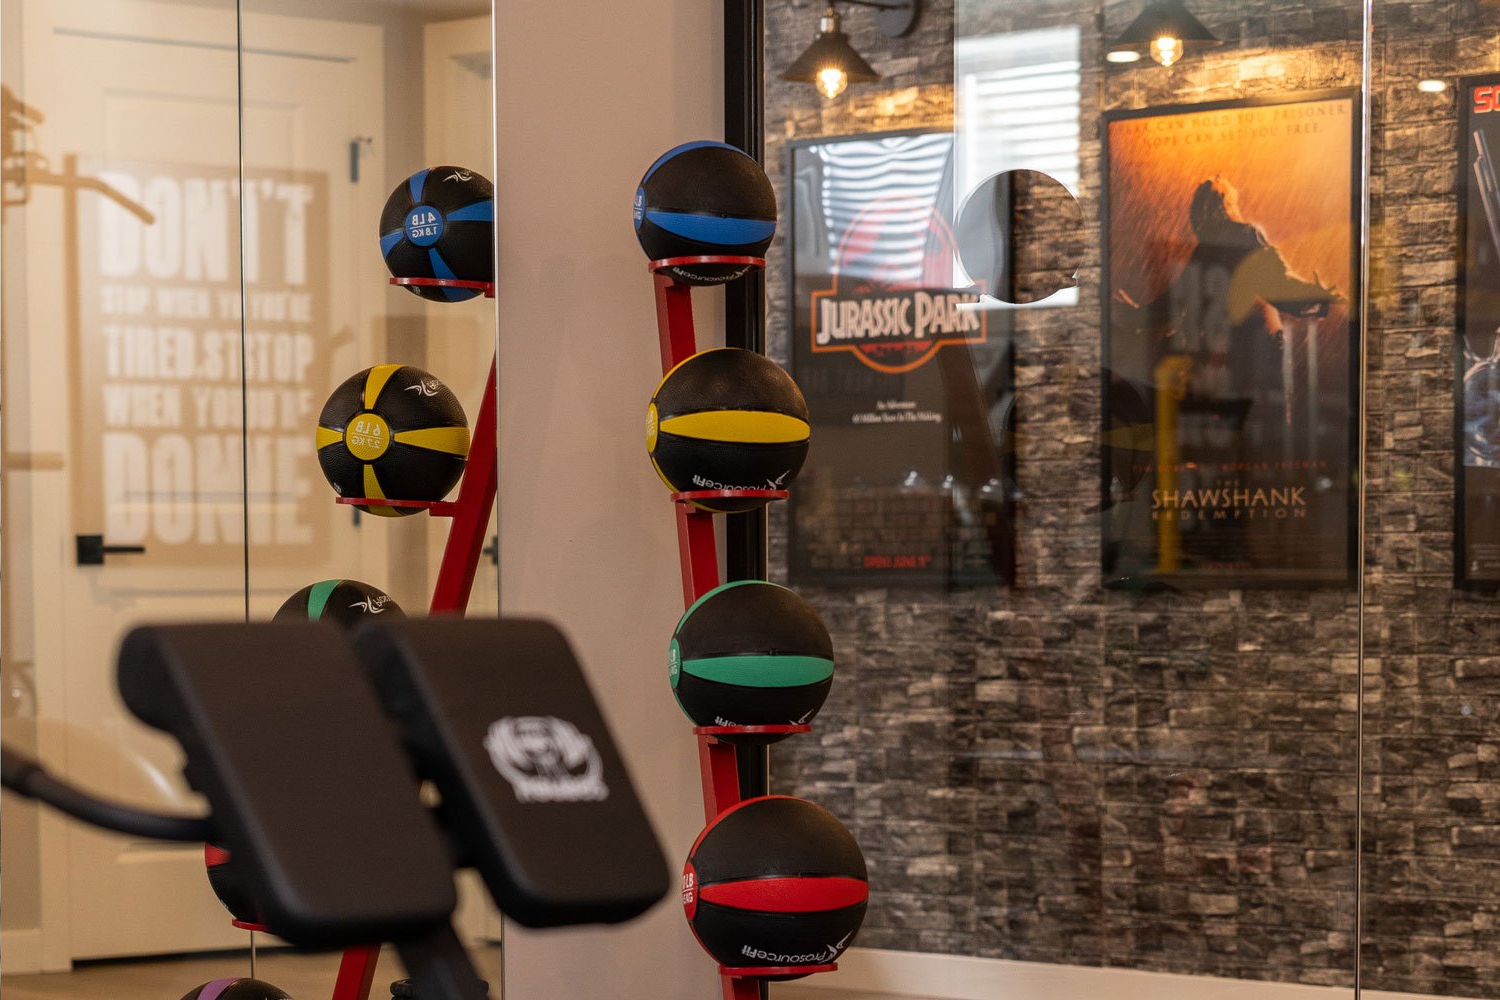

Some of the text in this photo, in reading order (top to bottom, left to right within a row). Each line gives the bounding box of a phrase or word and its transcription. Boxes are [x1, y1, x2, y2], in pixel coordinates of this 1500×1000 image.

[1192, 115, 1230, 129] HOLD
[1236, 110, 1264, 124] YOU
[1251, 126, 1279, 138] YOU
[816, 291, 981, 345] JURASSIC PARK
[1152, 486, 1307, 509] SHAWSHANK
